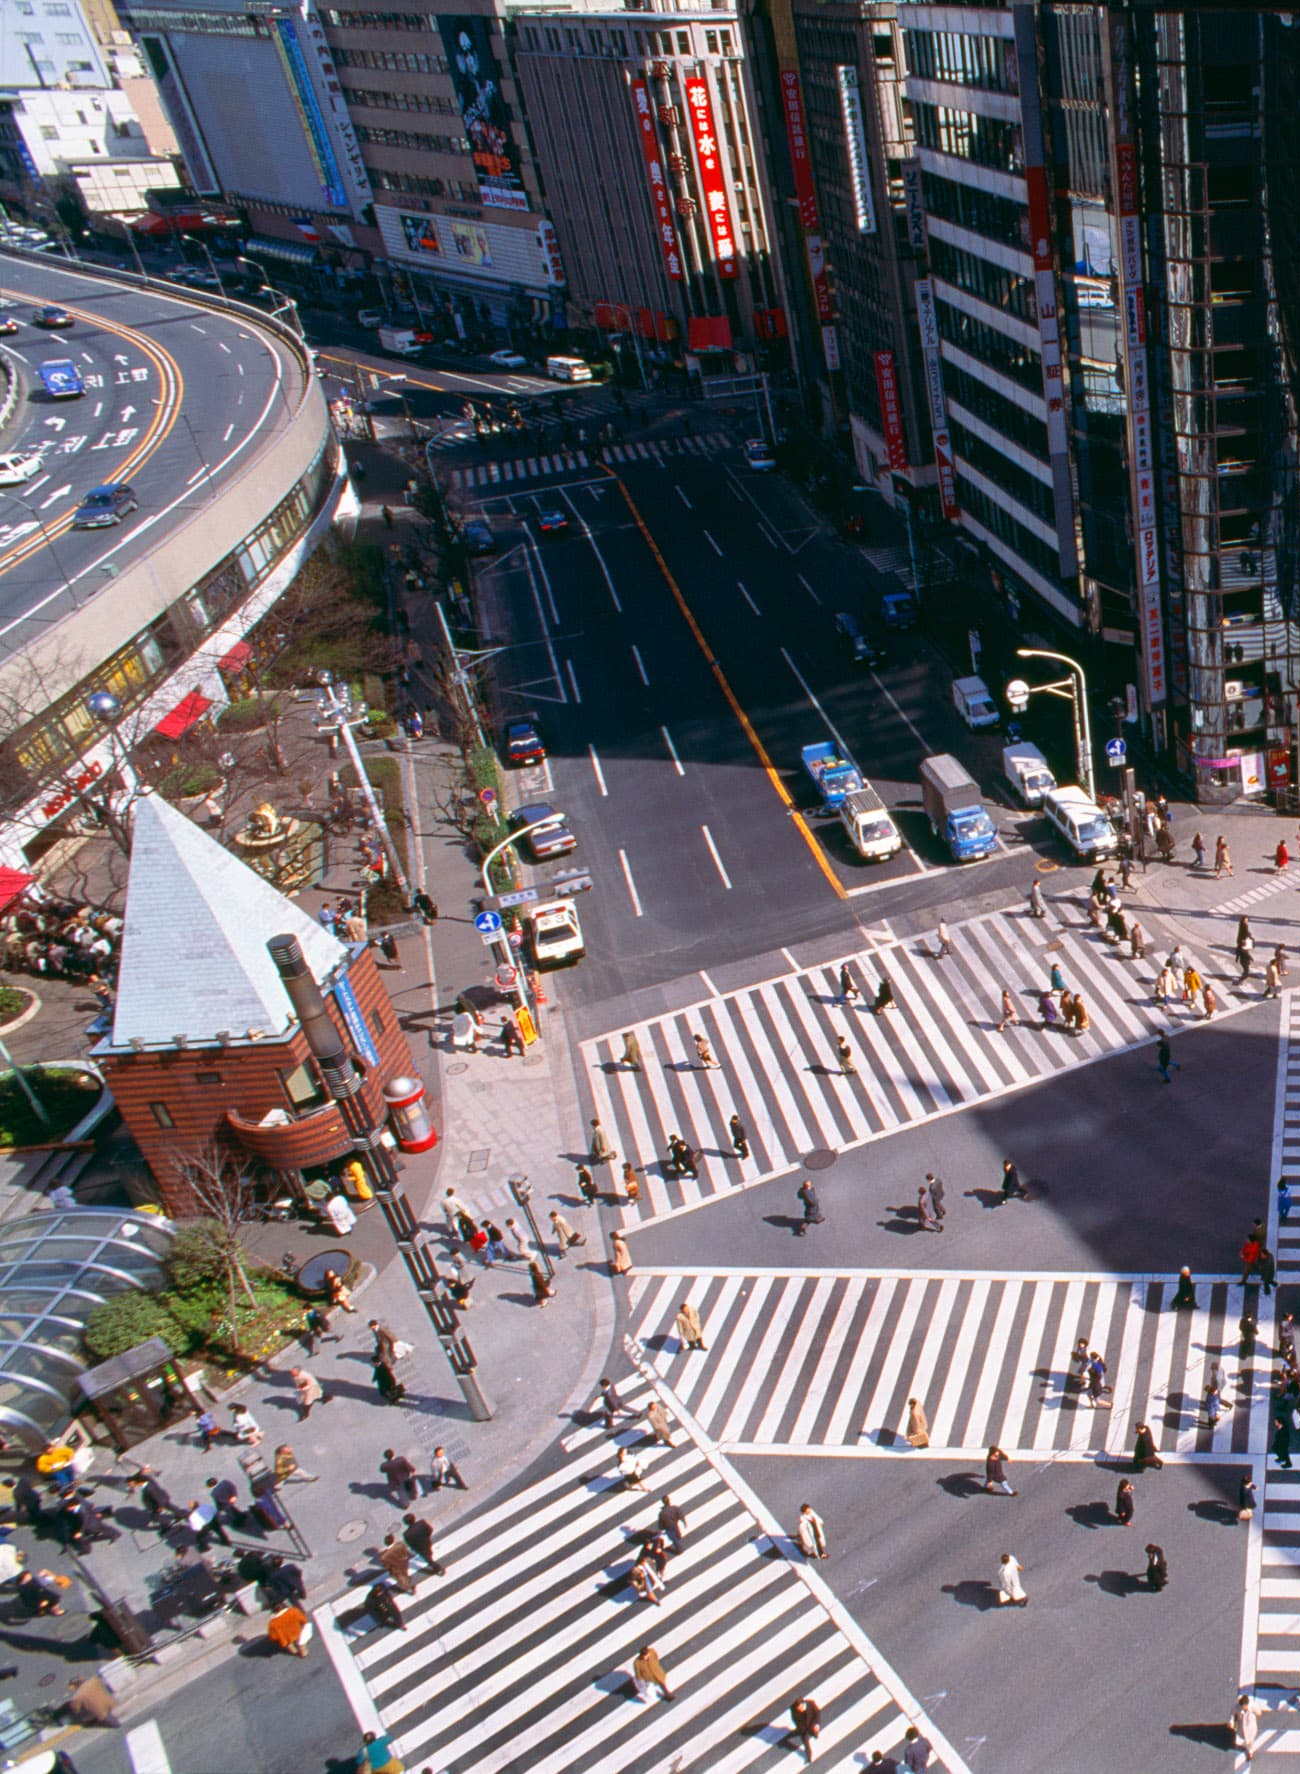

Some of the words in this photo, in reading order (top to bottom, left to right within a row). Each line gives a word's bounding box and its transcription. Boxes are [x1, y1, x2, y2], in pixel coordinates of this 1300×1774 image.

[688, 85, 716, 170] 花には水を
[114, 367, 149, 385] 上野
[1041, 303, 1061, 412] 山一証券
[90, 427, 139, 450] 上野
[1144, 531, 1156, 582] ロッテリア
